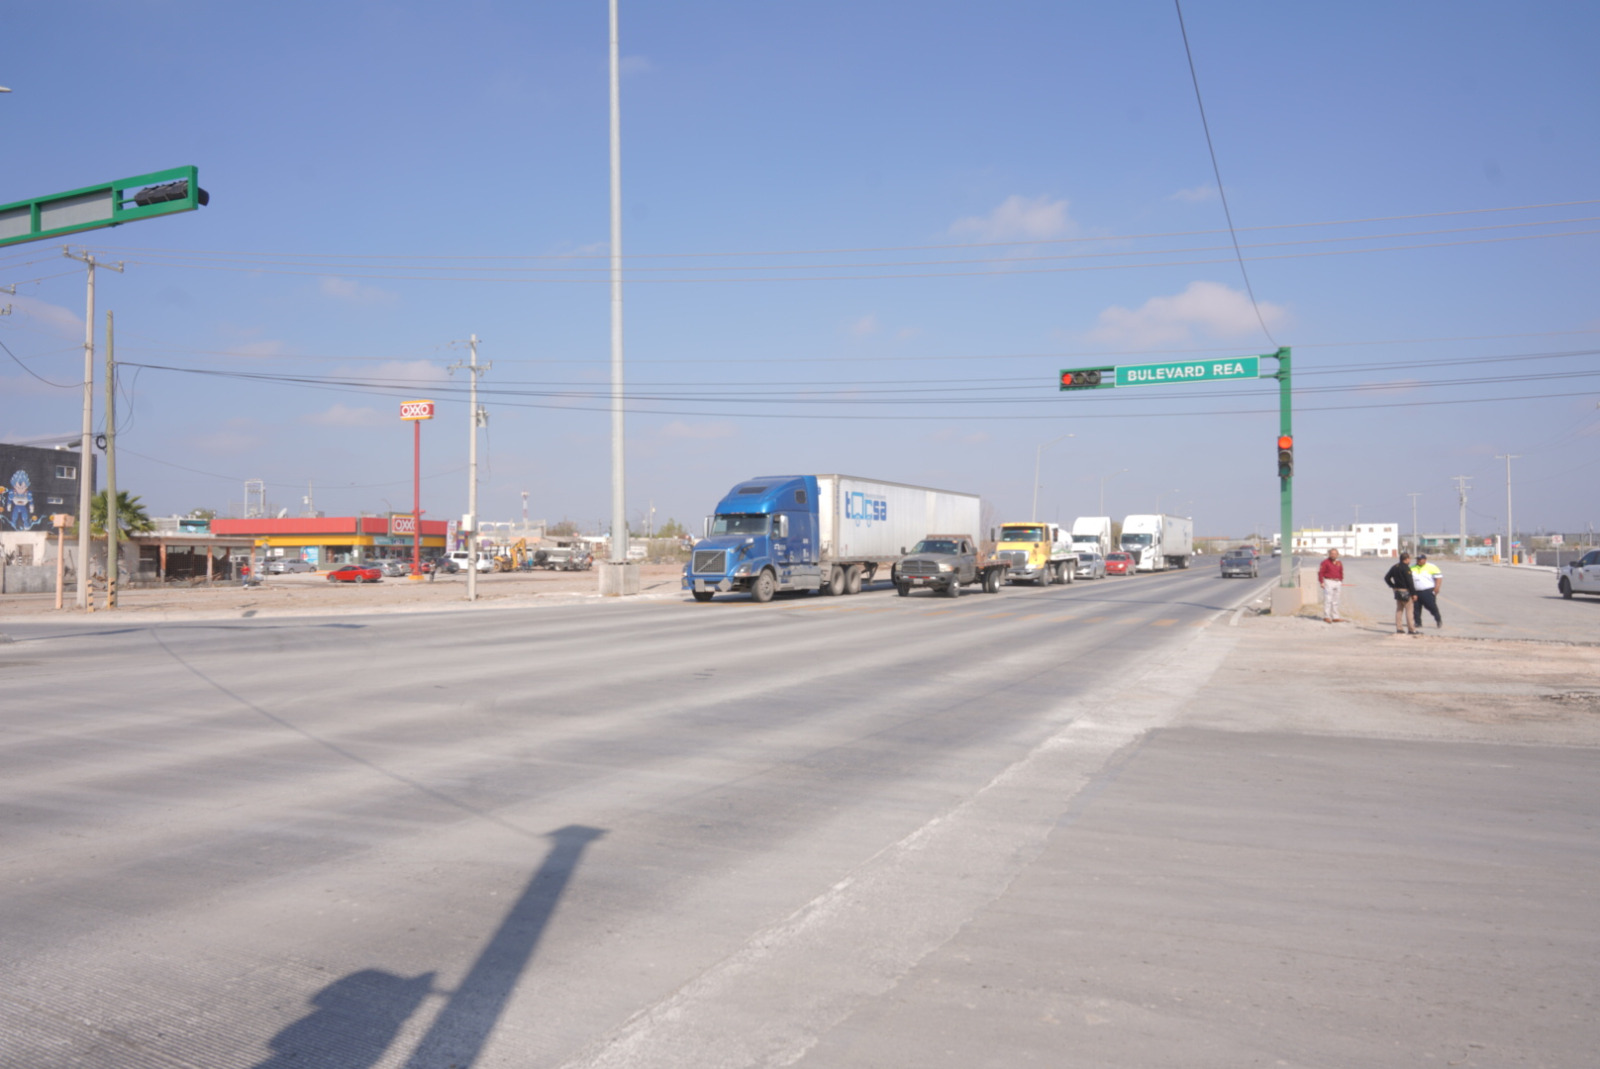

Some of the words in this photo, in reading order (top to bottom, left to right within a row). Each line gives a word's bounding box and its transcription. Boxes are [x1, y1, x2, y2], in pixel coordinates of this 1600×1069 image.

[1127, 365, 1205, 382] BULEVARD
[1212, 363, 1245, 376] REA
[401, 403, 430, 417] OXXO
